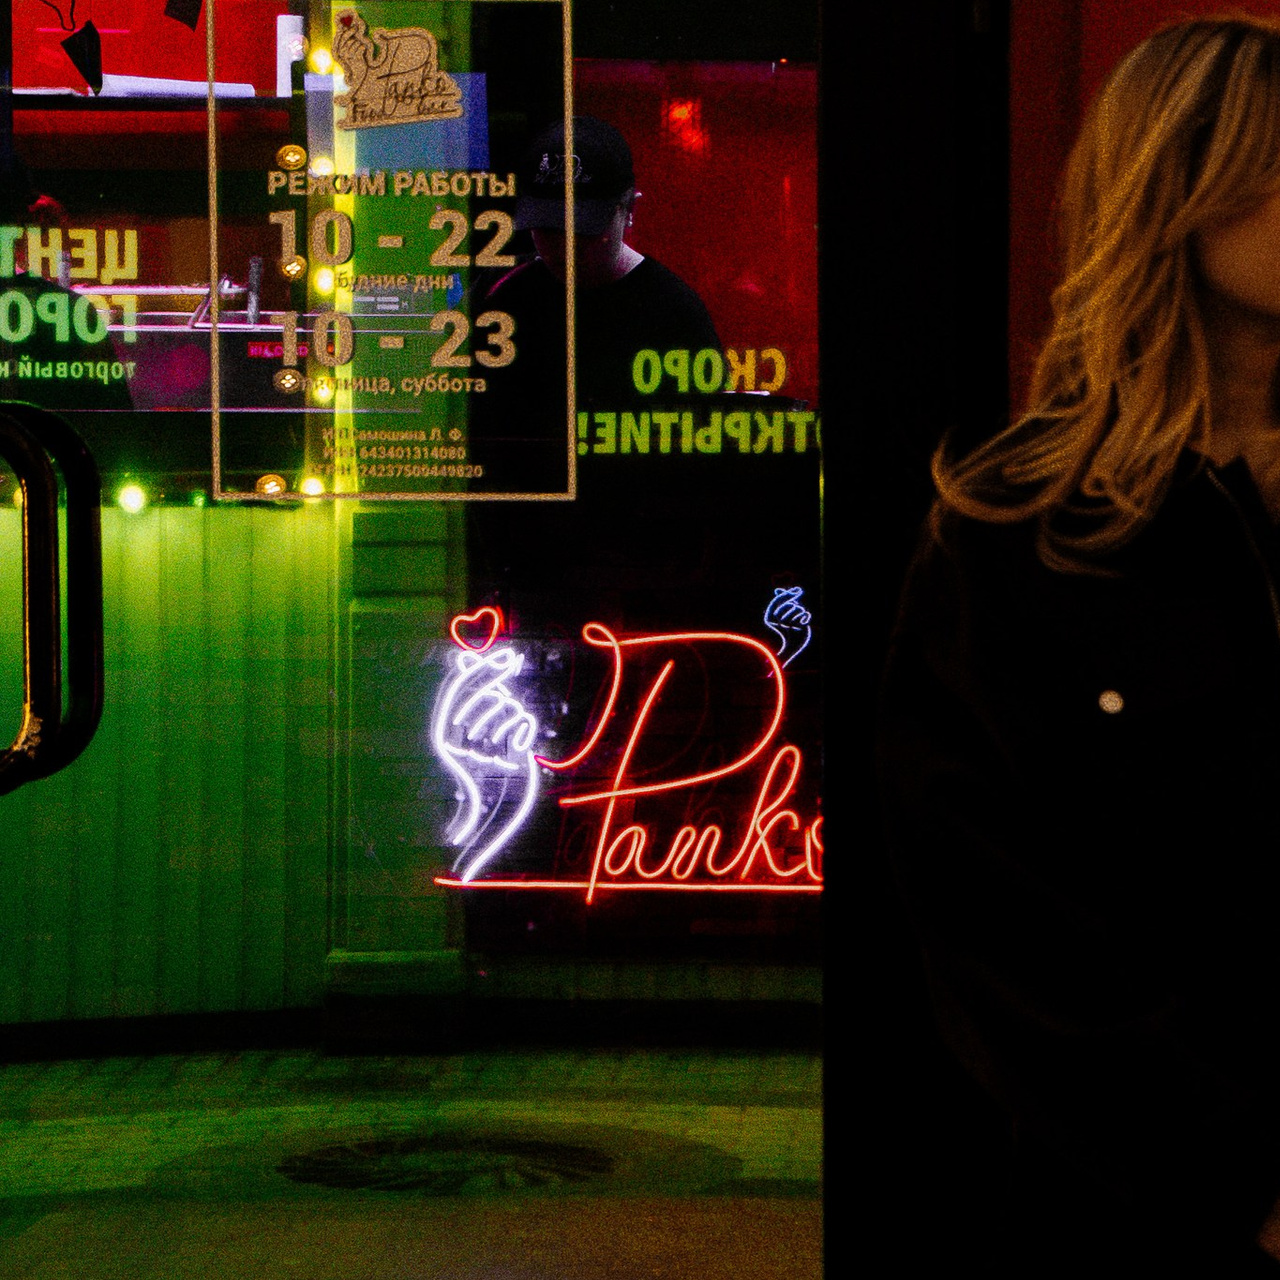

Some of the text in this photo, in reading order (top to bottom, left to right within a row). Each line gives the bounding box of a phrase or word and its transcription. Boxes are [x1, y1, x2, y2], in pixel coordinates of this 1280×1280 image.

[267, 171, 516, 197] РЕЖИМ РАБОТЫ
[268, 209, 353, 266] 10
[429, 209, 516, 267] 22
[414, 274, 454, 293] дни
[269, 310, 353, 367] 10
[430, 310, 516, 368] 23
[401, 372, 487, 396] суббота
